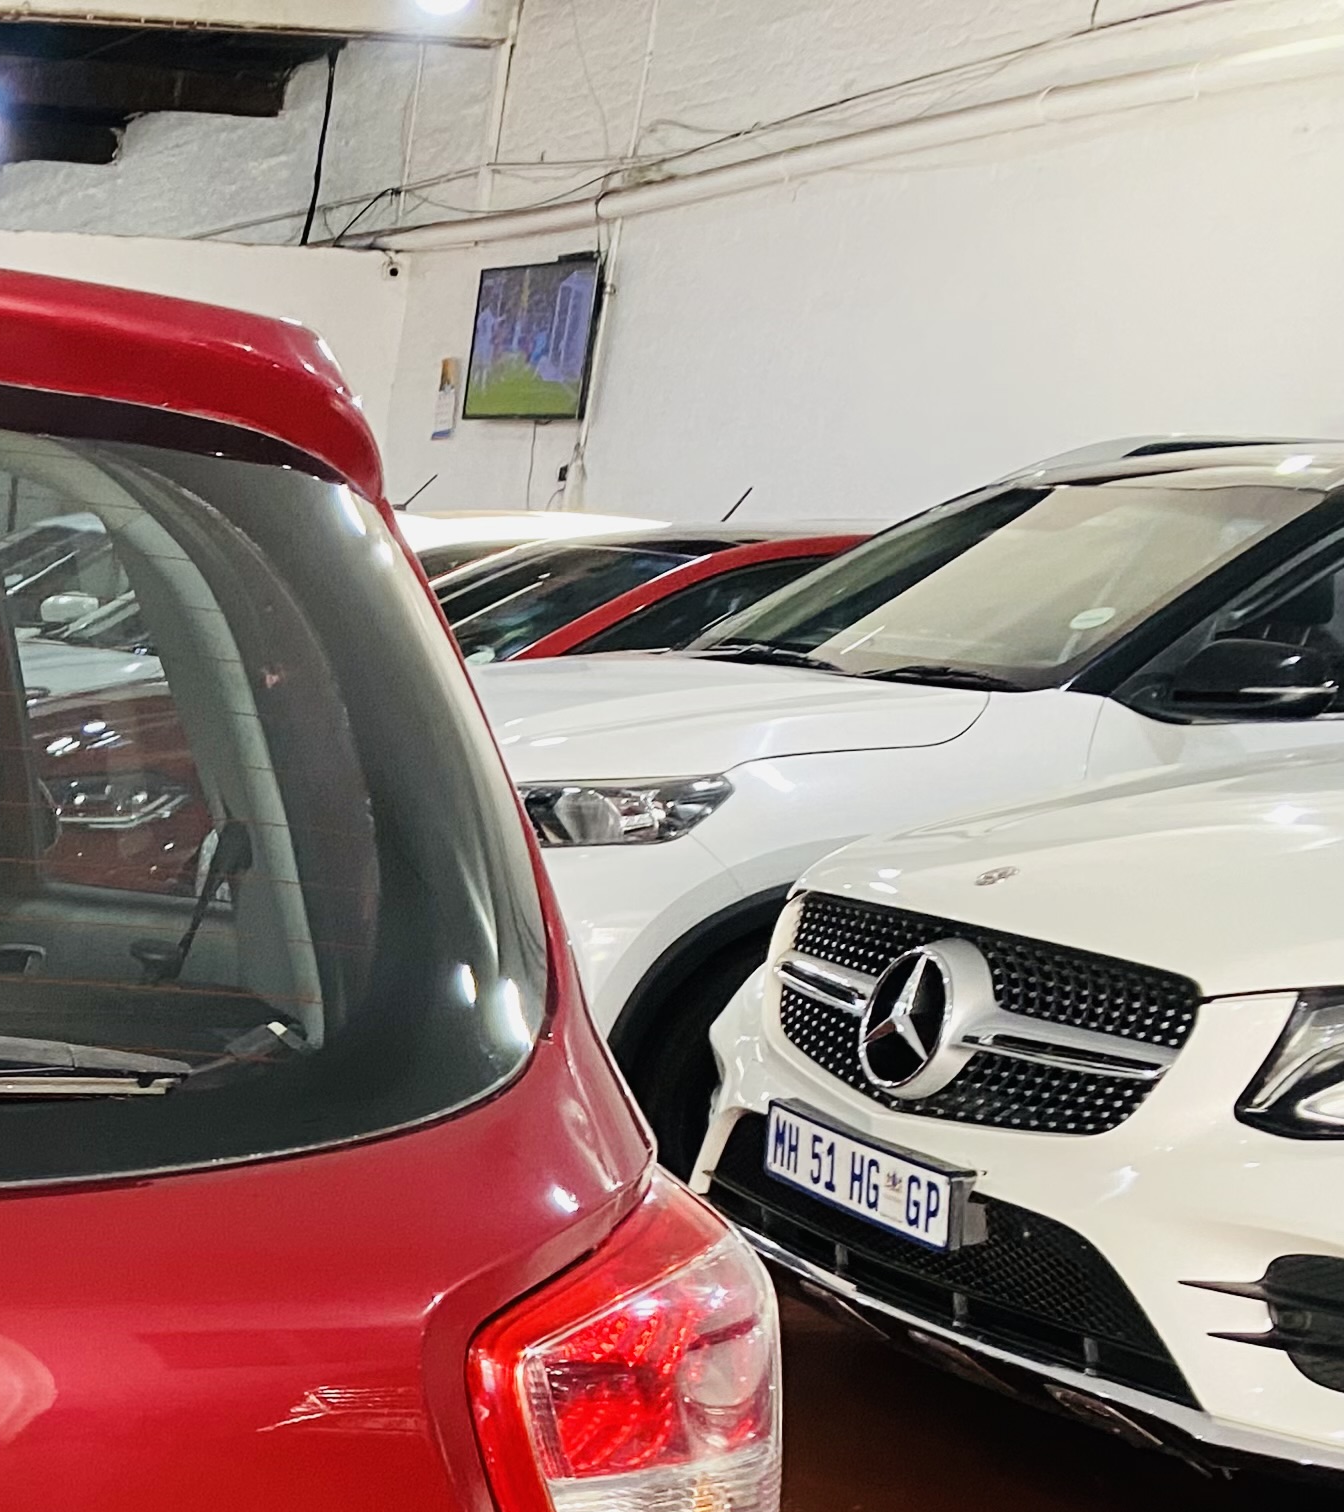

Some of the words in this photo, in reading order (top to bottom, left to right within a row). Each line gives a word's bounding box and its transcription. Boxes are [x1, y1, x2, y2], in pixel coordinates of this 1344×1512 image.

[773, 1114, 800, 1174] MH
[810, 1134, 837, 1193] 51
[849, 1151, 880, 1212] HG
[905, 1174, 940, 1233] GP
